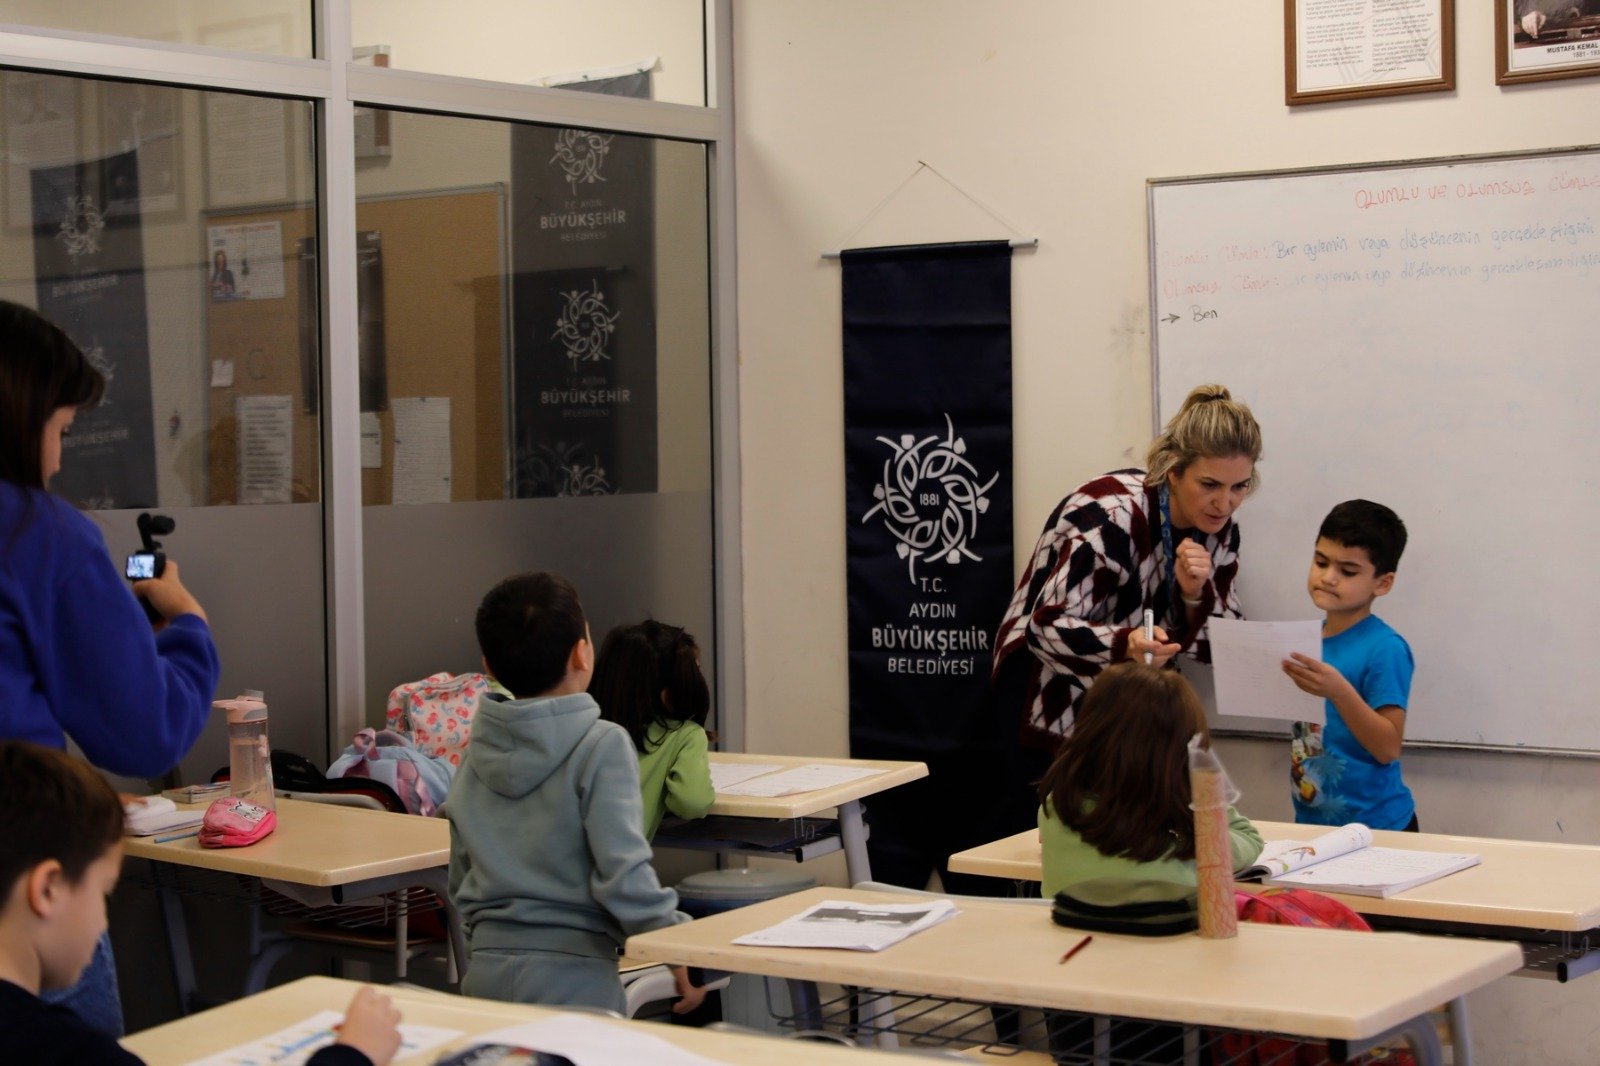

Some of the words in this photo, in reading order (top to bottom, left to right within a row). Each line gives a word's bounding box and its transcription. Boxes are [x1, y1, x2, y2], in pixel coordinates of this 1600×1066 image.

[1546, 45, 1576, 53] MUSTAFA
[1577, 42, 1599, 50] KEMAL
[1355, 186, 1419, 209] OLUMLU
[1428, 184, 1448, 199] VE
[1456, 179, 1536, 198] OLUMSUZ
[540, 208, 627, 230] BÜYÜKŞEHİR
[1359, 238, 1390, 258] veya
[1191, 303, 1219, 322] Ben
[540, 386, 632, 407] BÜYÜKŞEHİR
[919, 493, 940, 506] 1881
[919, 577, 947, 593] T.C.
[908, 603, 957, 619] AYDIN
[871, 624, 989, 657] BÜYÜKŞEHİR
[887, 656, 975, 676] BELEDİYESİ
